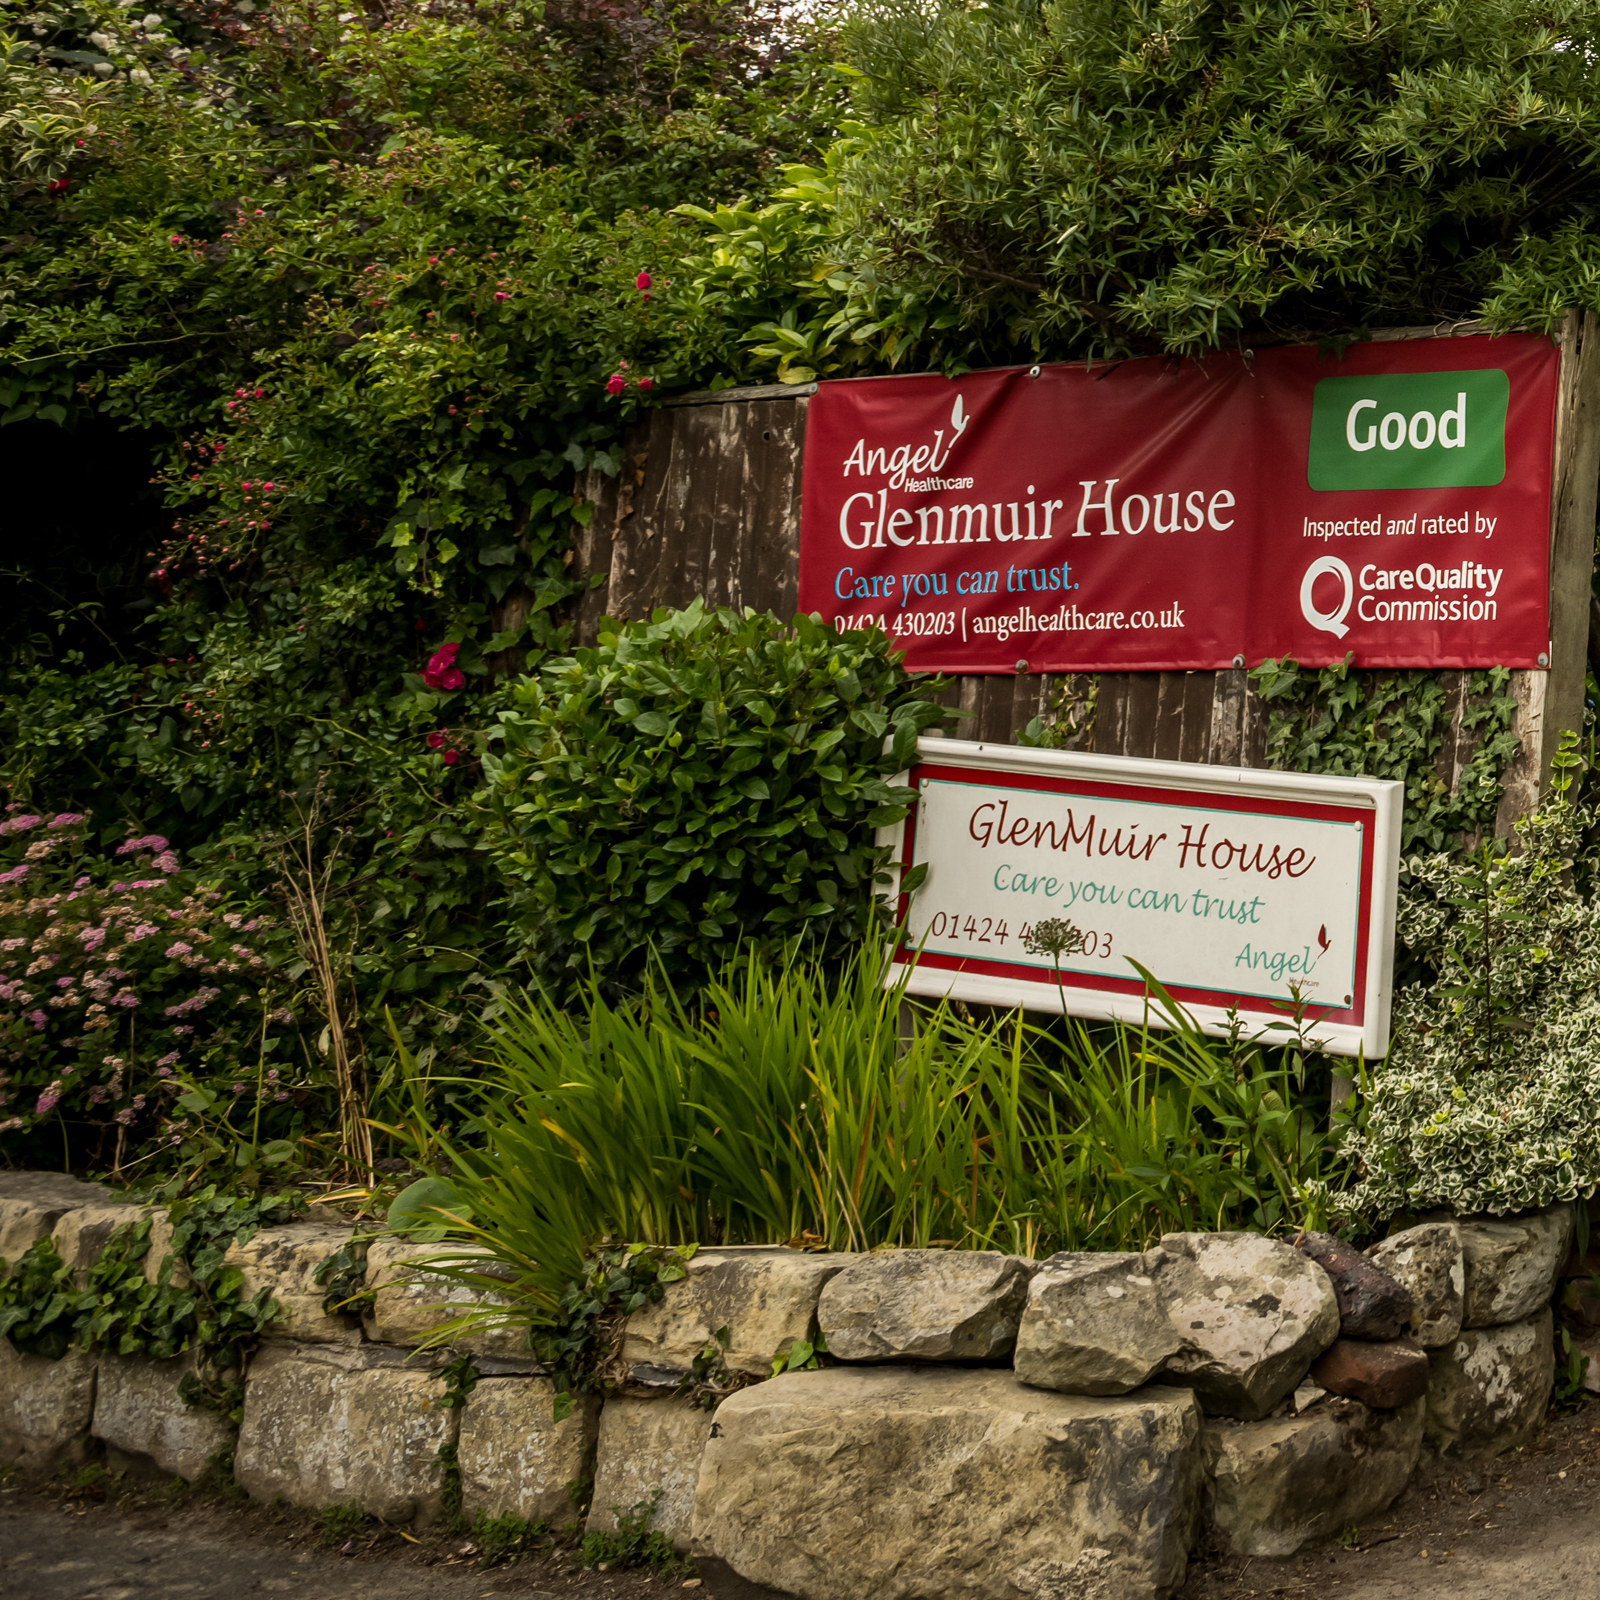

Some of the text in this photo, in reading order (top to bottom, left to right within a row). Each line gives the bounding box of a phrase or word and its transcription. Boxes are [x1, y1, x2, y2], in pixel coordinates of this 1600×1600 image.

[1346, 392, 1467, 452] Good
[843, 429, 950, 490] Angel
[904, 476, 974, 493] Healthcare
[839, 479, 1235, 550] Glenmuir House
[1303, 511, 1497, 542] Inspected and rated by
[834, 561, 1080, 607] Care you can trust.
[892, 611, 956, 636] 430203
[972, 601, 1185, 641] angelhealthcare.co.uk
[1358, 594, 1497, 622] Commission
[969, 800, 1316, 879] GlenMuir House
[993, 864, 1266, 925] Care you can trust
[932, 911, 1009, 945] 01424
[1235, 943, 1317, 981] Angel
